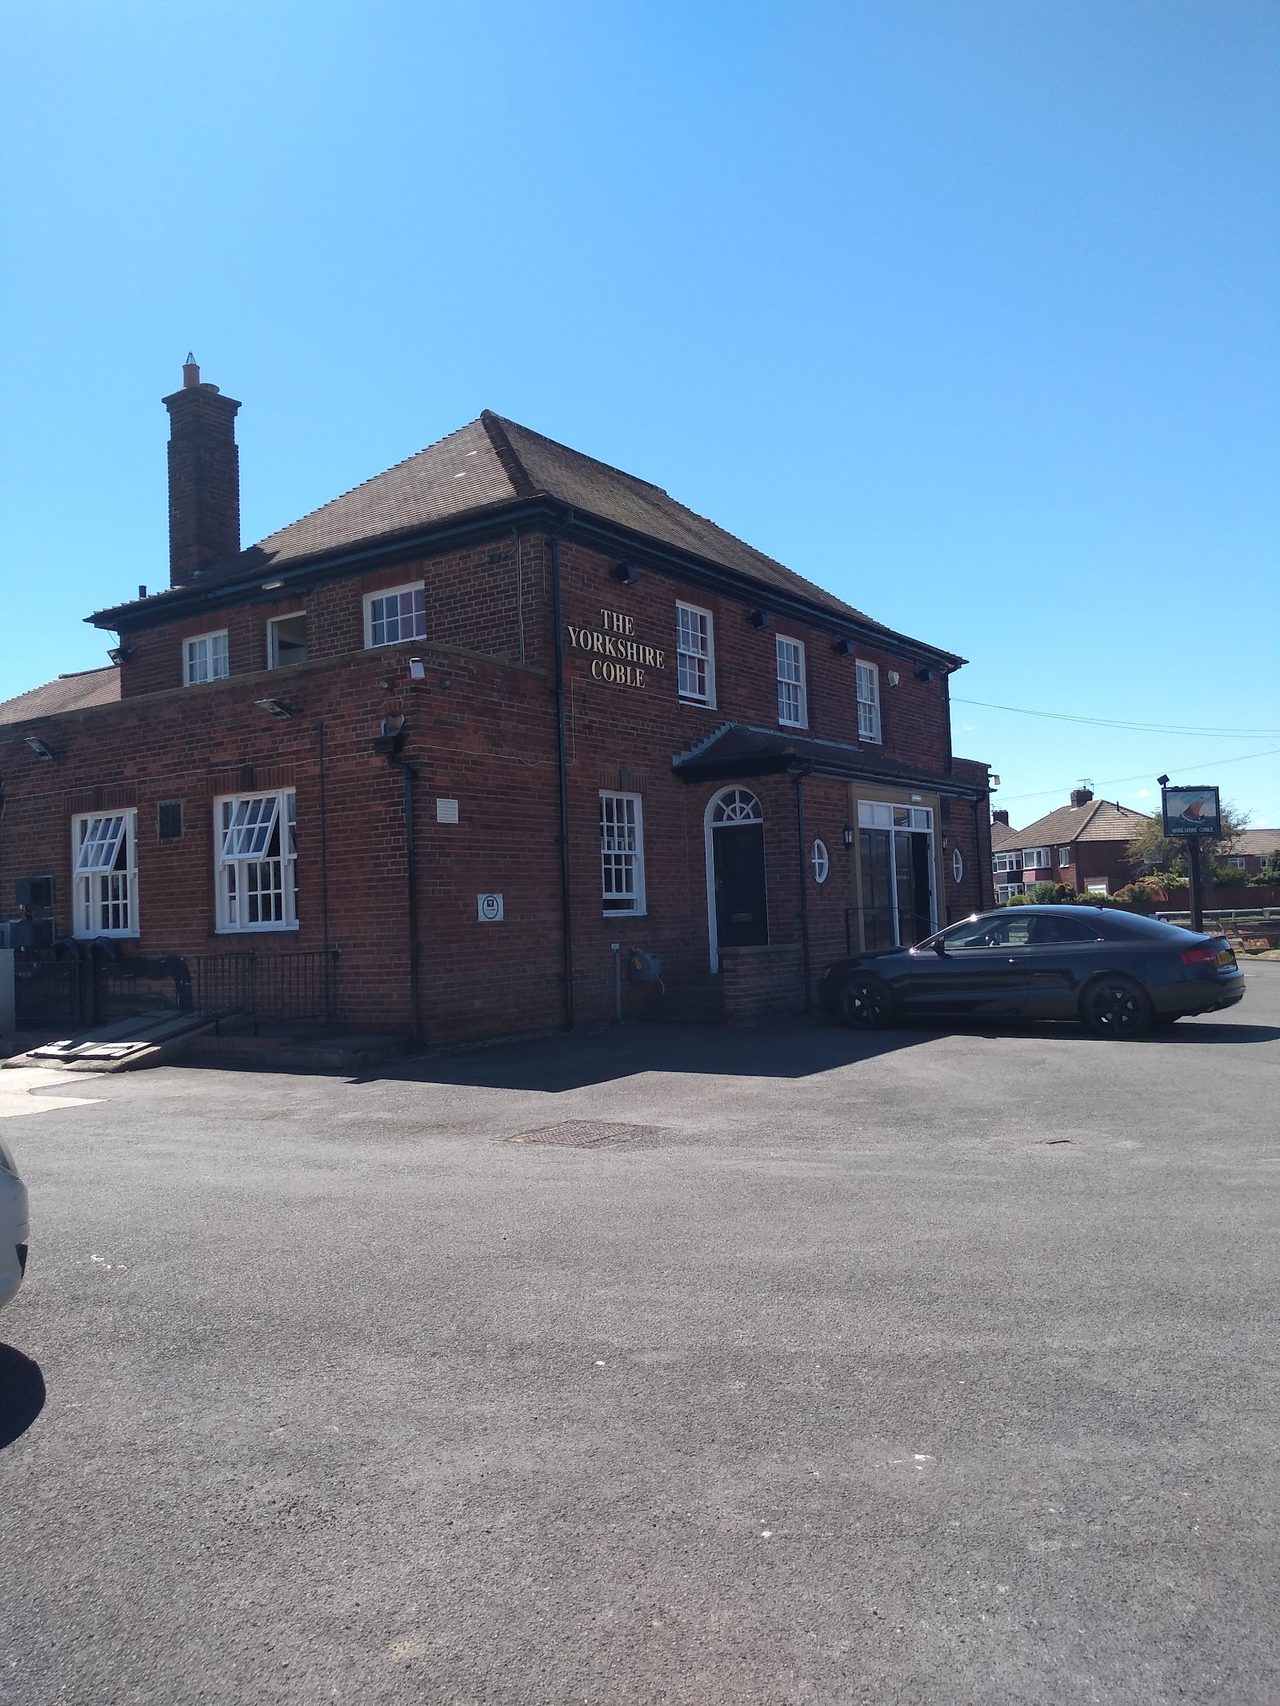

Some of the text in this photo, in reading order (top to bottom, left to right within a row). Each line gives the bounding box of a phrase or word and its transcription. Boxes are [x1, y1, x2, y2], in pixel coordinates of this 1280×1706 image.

[601, 609, 635, 636] THE
[567, 626, 665, 669] YORKSHIRE
[591, 659, 645, 688] COBLE
